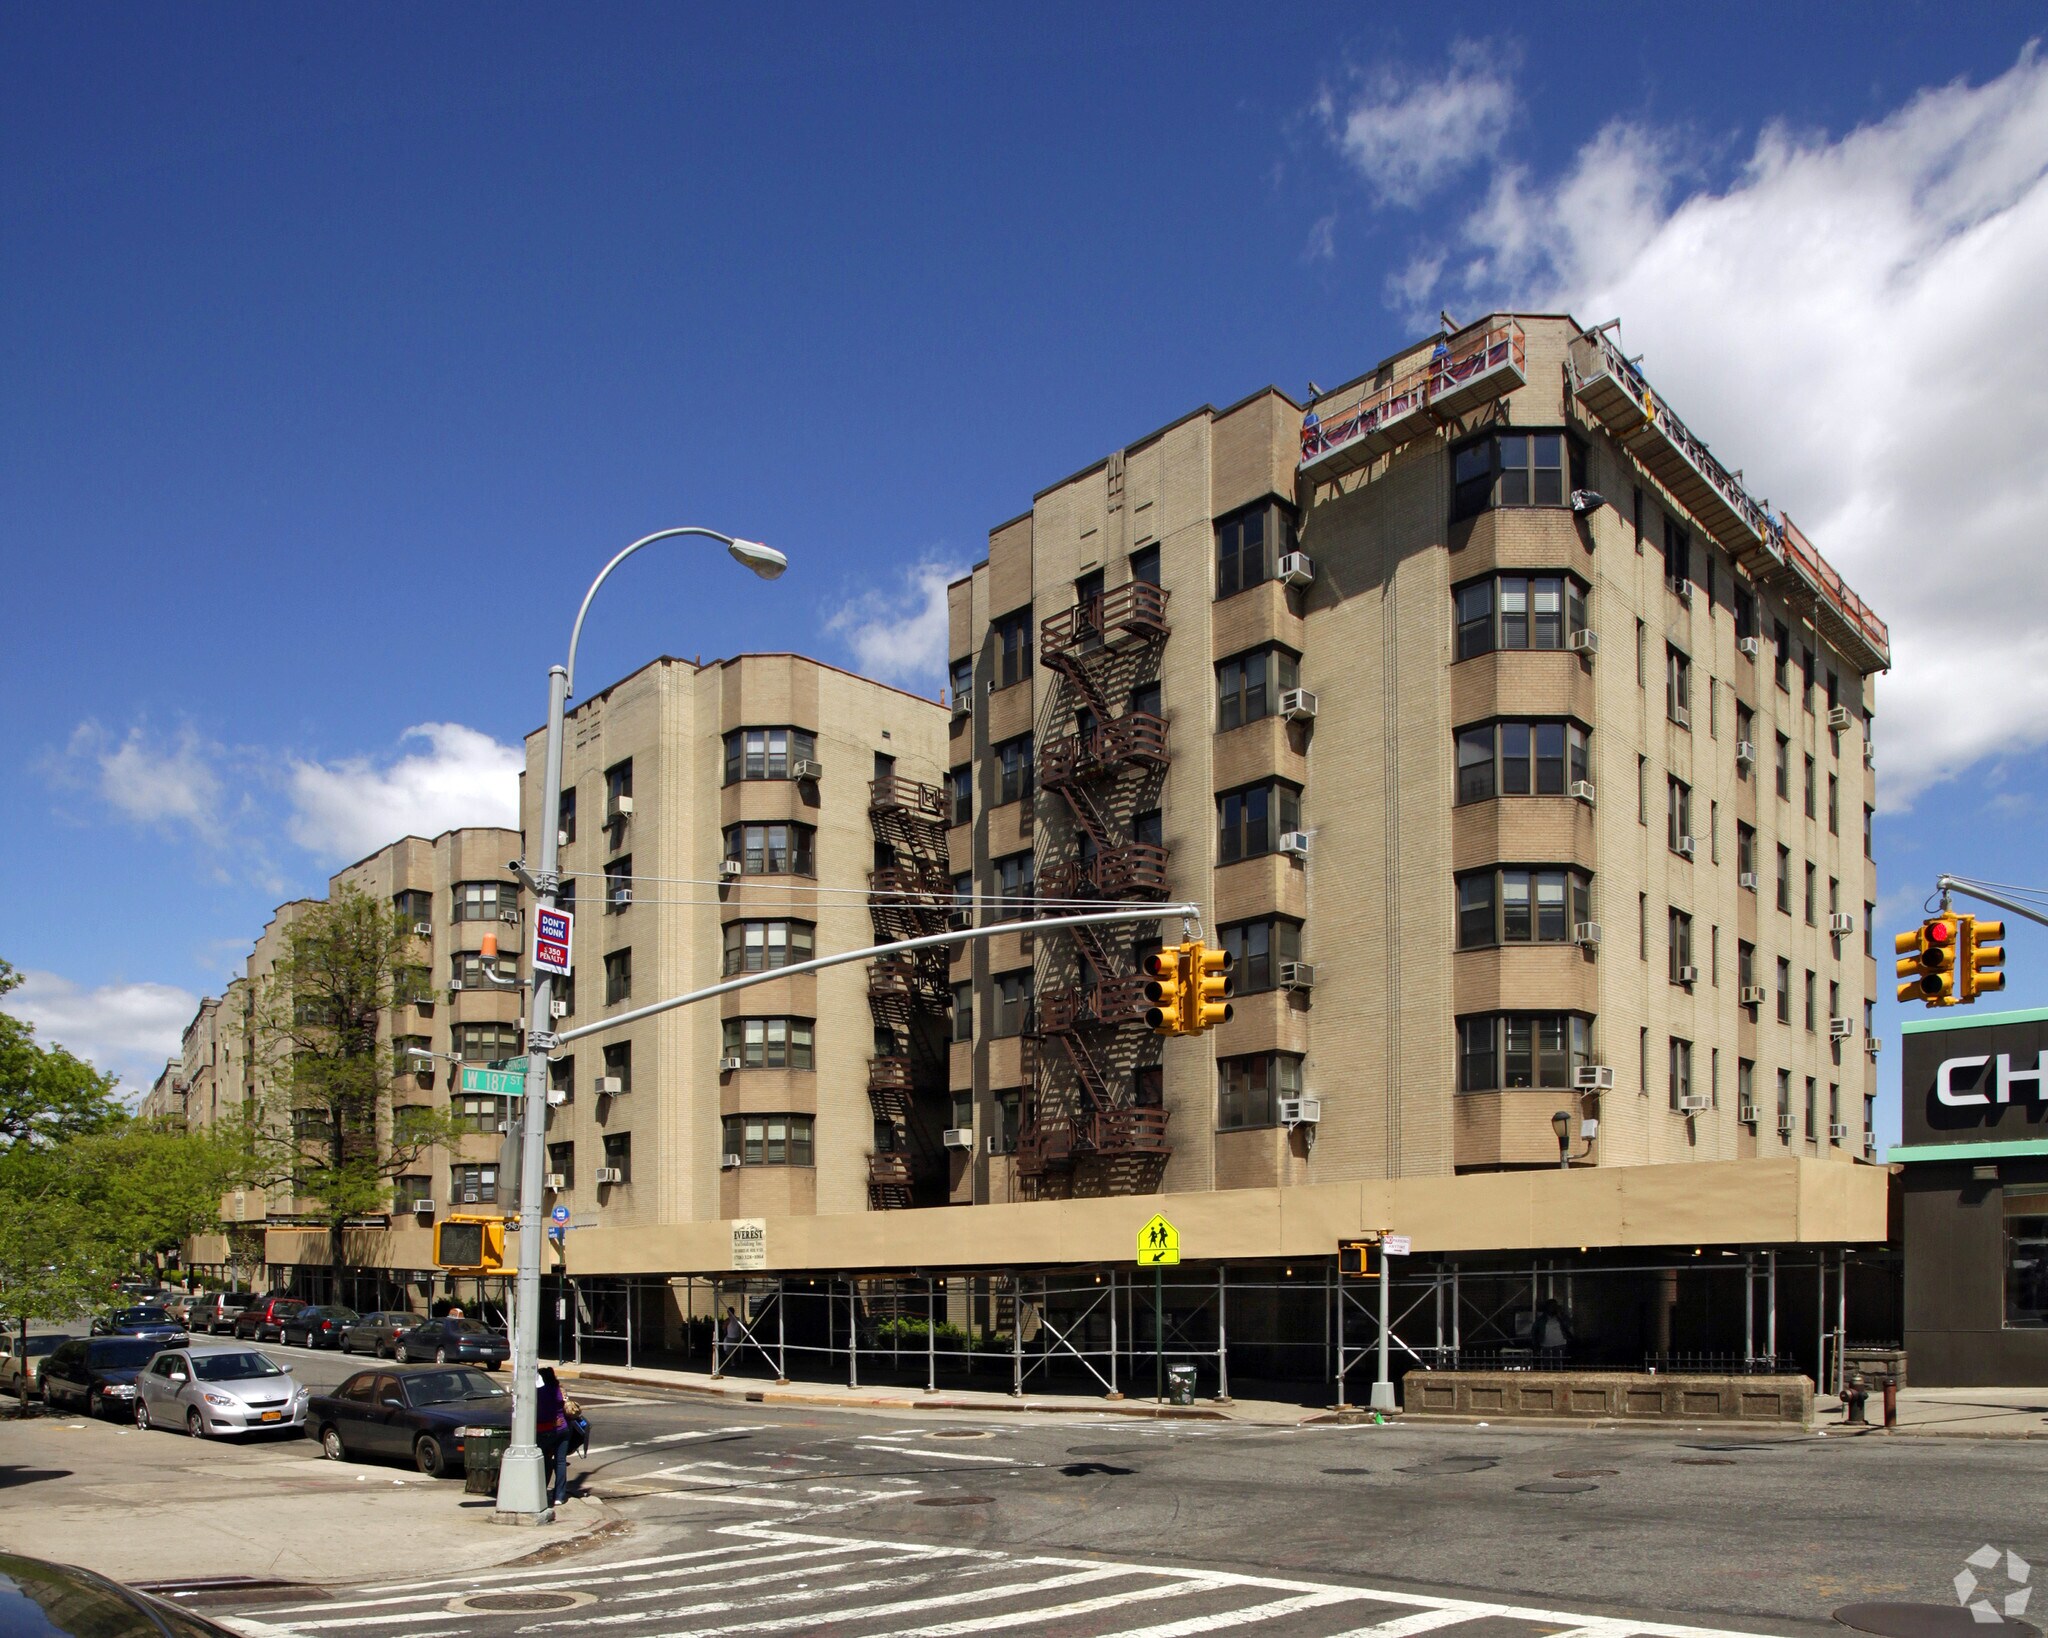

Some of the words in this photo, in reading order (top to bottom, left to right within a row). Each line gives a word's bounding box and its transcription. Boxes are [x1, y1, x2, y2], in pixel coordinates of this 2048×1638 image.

[542, 916, 565, 929] DON'T
[542, 926, 564, 938] HONK
[539, 951, 564, 964] PENALTY
[467, 1071, 478, 1089] W
[486, 1072, 508, 1092] 187
[510, 1075, 521, 1085] ST
[734, 1230, 763, 1240] EVEREST
